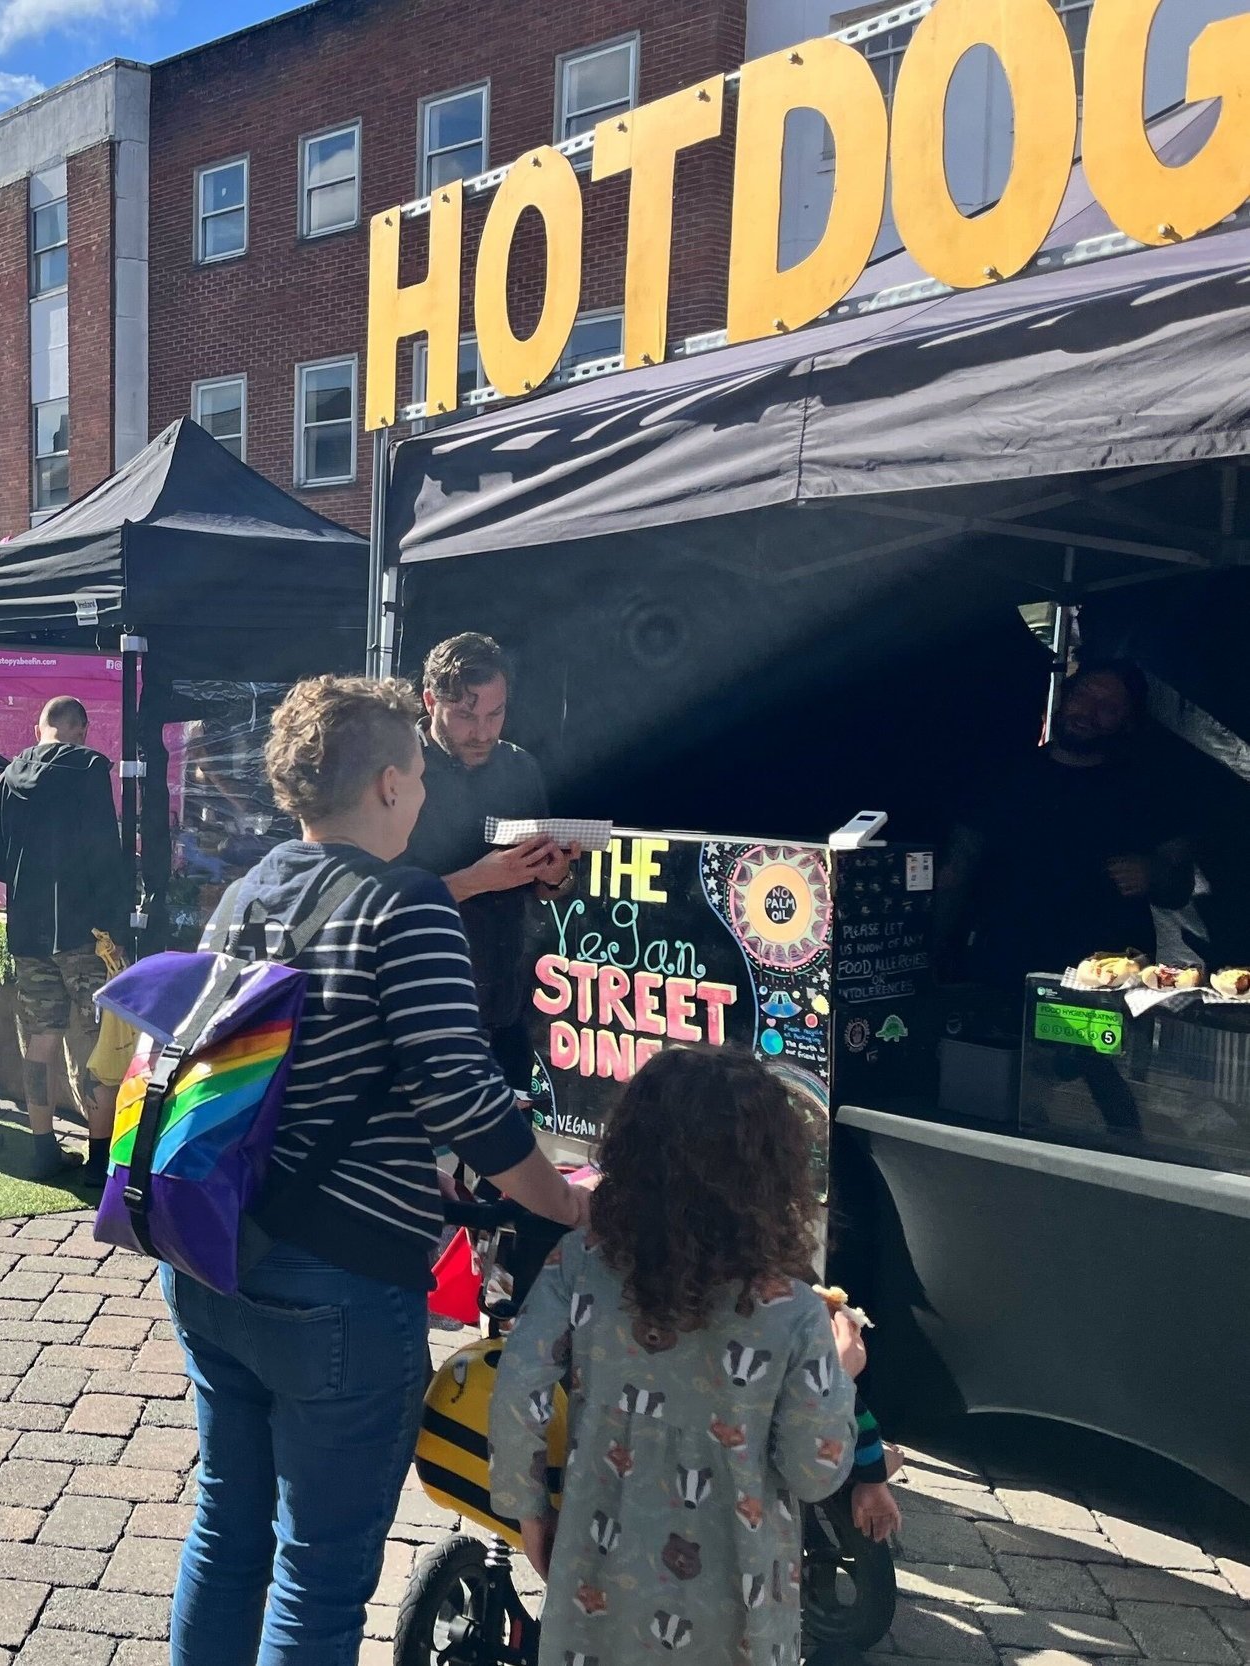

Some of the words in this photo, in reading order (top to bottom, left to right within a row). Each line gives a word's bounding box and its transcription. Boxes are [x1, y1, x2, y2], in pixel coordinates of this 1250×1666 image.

[590, 839, 669, 903] THE
[772, 887, 790, 899] NO
[765, 897, 796, 910] PALM
[771, 909, 791, 921] OIL
[843, 922, 880, 939] PLEASE
[884, 922, 904, 936] LET
[540, 899, 706, 980] Vegan
[839, 943, 852, 956] US
[856, 941, 884, 954] KNOW
[903, 933, 924, 947] ANY
[838, 960, 871, 975] FOOD
[871, 972, 886, 985] OR
[532, 954, 737, 1047] STREET
[1104, 1032, 1113, 1044] 5
[550, 1021, 663, 1084] DINE
[557, 1114, 596, 1136] VEGAN
